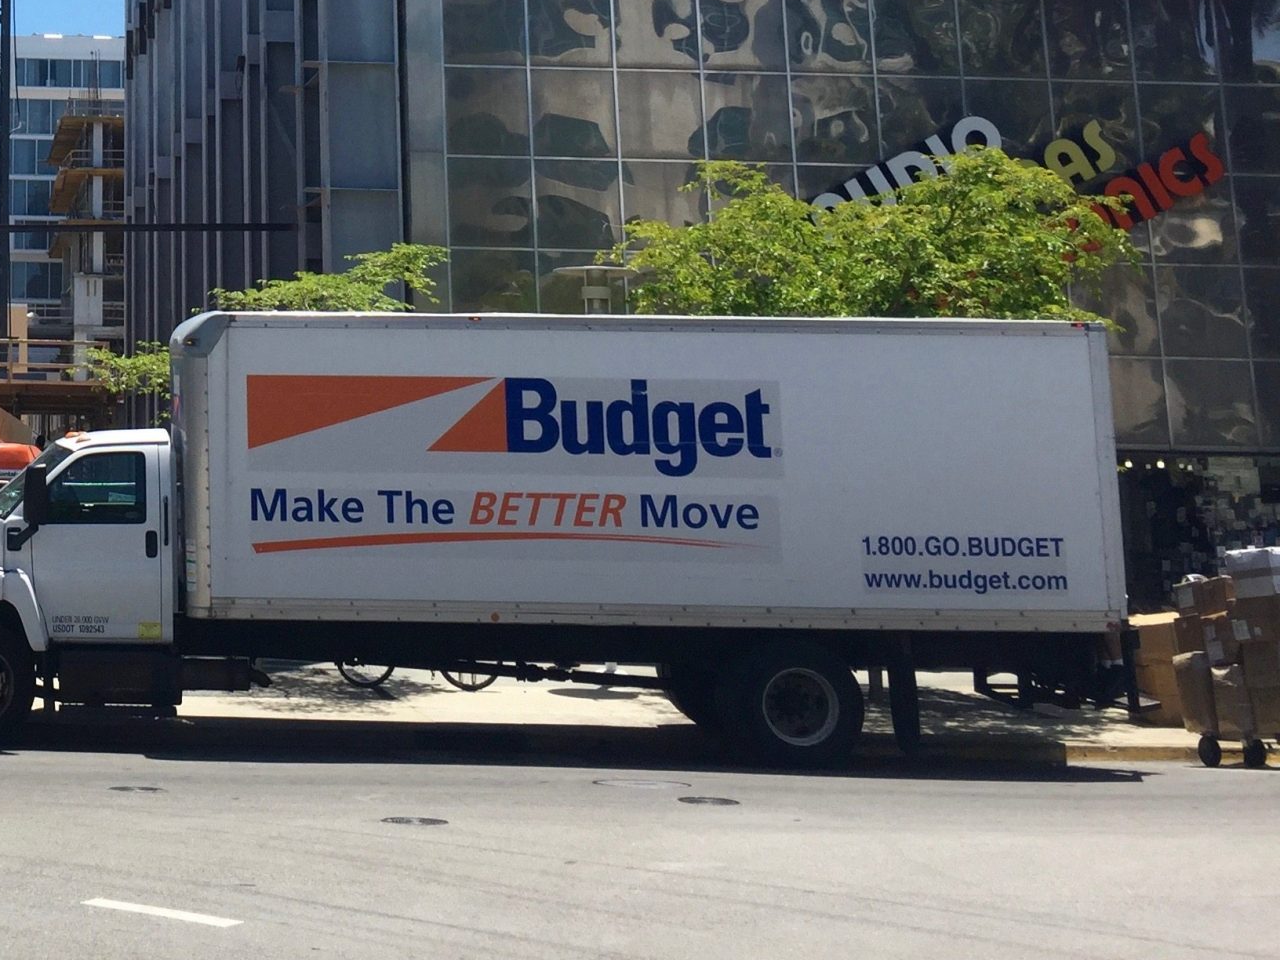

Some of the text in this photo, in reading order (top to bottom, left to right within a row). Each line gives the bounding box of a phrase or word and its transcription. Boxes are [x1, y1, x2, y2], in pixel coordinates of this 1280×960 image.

[504, 377, 772, 477] Budget
[250, 487, 760, 530] Make The BETTER Move
[862, 536, 1064, 558] 1.800.GO.BUDGET
[864, 570, 1068, 594] www.budget.com
[52, 624, 74, 633] USDOT
